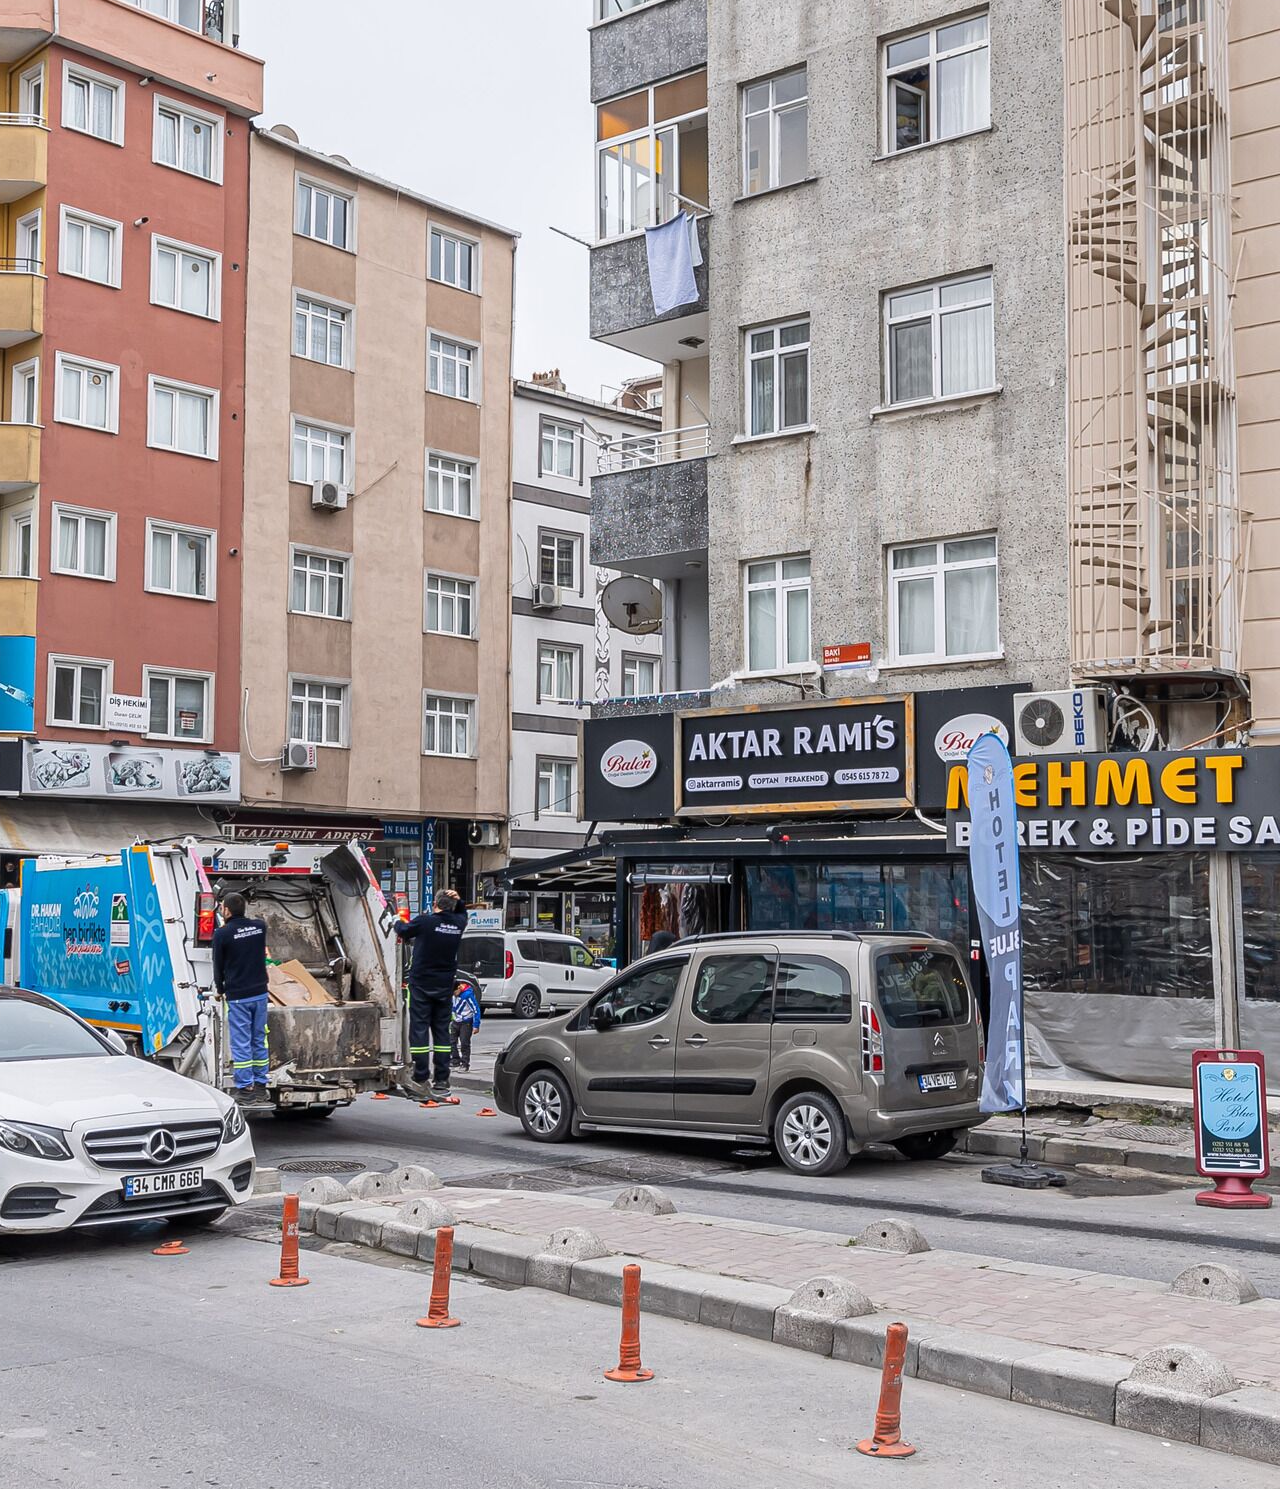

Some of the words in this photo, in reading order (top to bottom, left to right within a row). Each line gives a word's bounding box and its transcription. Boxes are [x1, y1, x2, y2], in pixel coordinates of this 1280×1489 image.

[109, 696, 121, 707] DİŞ
[122, 699, 148, 709] HEKİMİ
[1072, 692, 1085, 746] BEKO
[688, 728, 783, 761] AKTAR
[604, 753, 651, 772] Balen
[696, 778, 740, 789] aktarramis
[752, 777, 779, 785] TOPTAN
[785, 774, 825, 784] PERAKENDE
[841, 772, 857, 781] 0545
[858, 772, 870, 781] 615
[871, 771, 880, 780] 78
[881, 771, 890, 780] 72
[237, 827, 318, 840] KALİTENİN
[322, 830, 375, 841] ADRESİ
[395, 825, 419, 835] EMLAK
[955, 819, 1079, 848] BEK
[1089, 818, 1117, 846] &
[1126, 808, 1216, 846] PİDE
[218, 860, 229, 870] 34
[252, 860, 267, 871] 930
[1210, 1087, 1254, 1103] Hotel
[1222, 1104, 1256, 1118] Blue
[1211, 1119, 1246, 1133] Park
[133, 1177, 149, 1194] 34
[153, 1174, 176, 1192] CMR
[179, 1170, 200, 1188] 666
